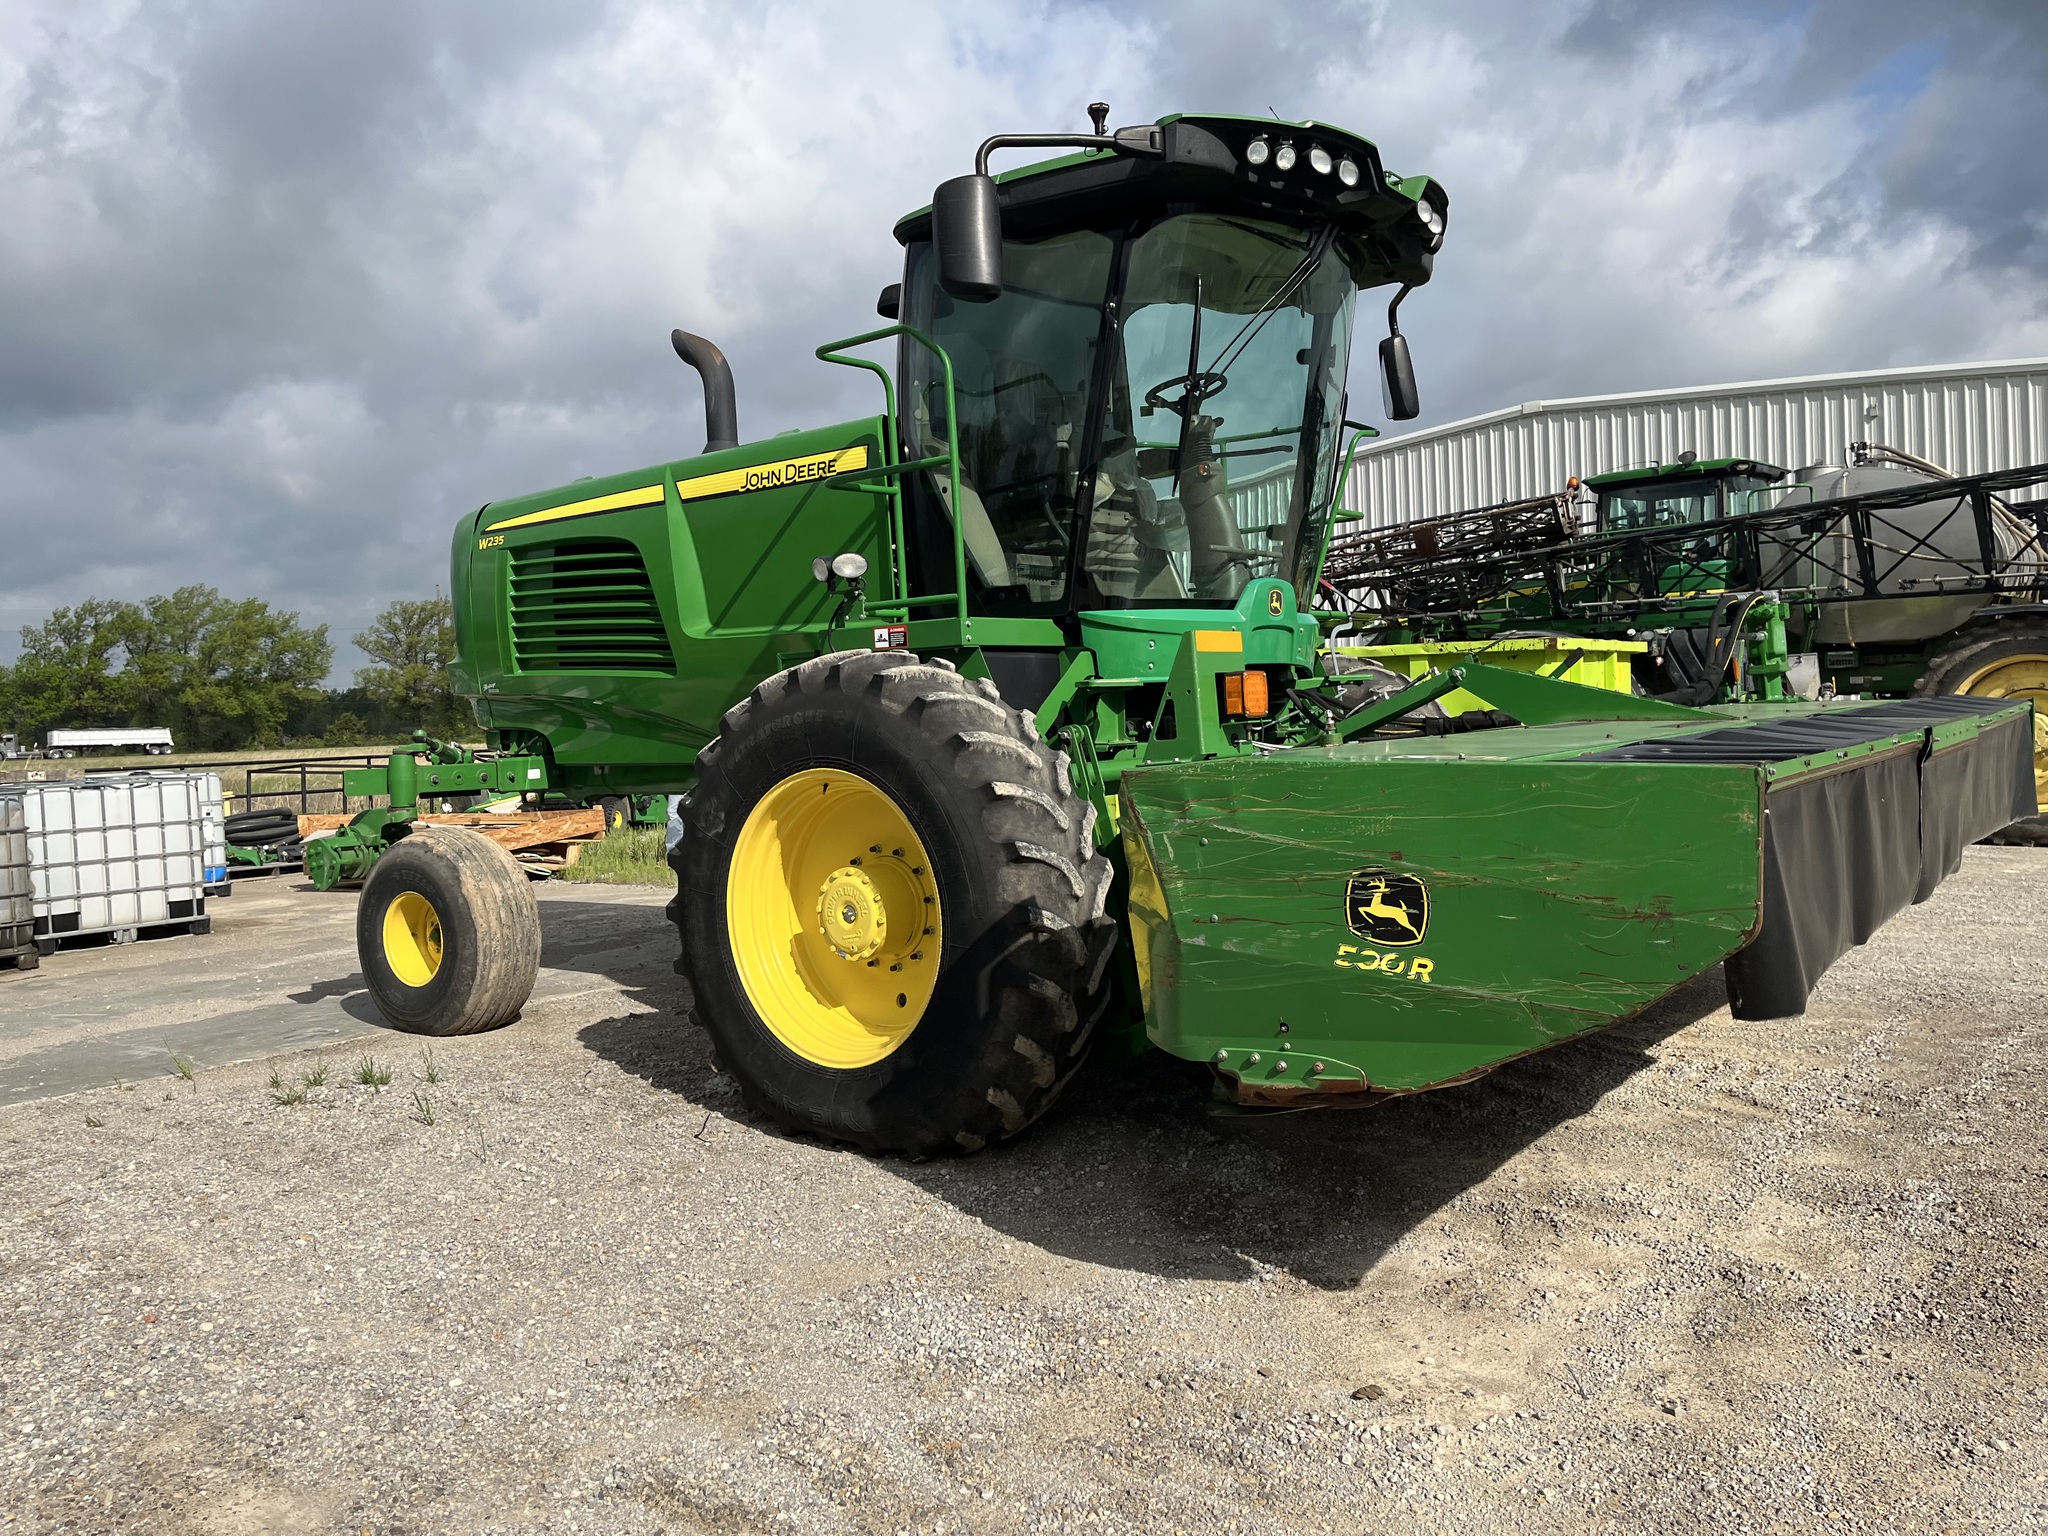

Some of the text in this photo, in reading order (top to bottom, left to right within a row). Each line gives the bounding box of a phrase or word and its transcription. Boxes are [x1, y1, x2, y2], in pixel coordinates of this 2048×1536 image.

[740, 459, 838, 490] JOHN DEERE
[479, 535, 505, 550] W235
